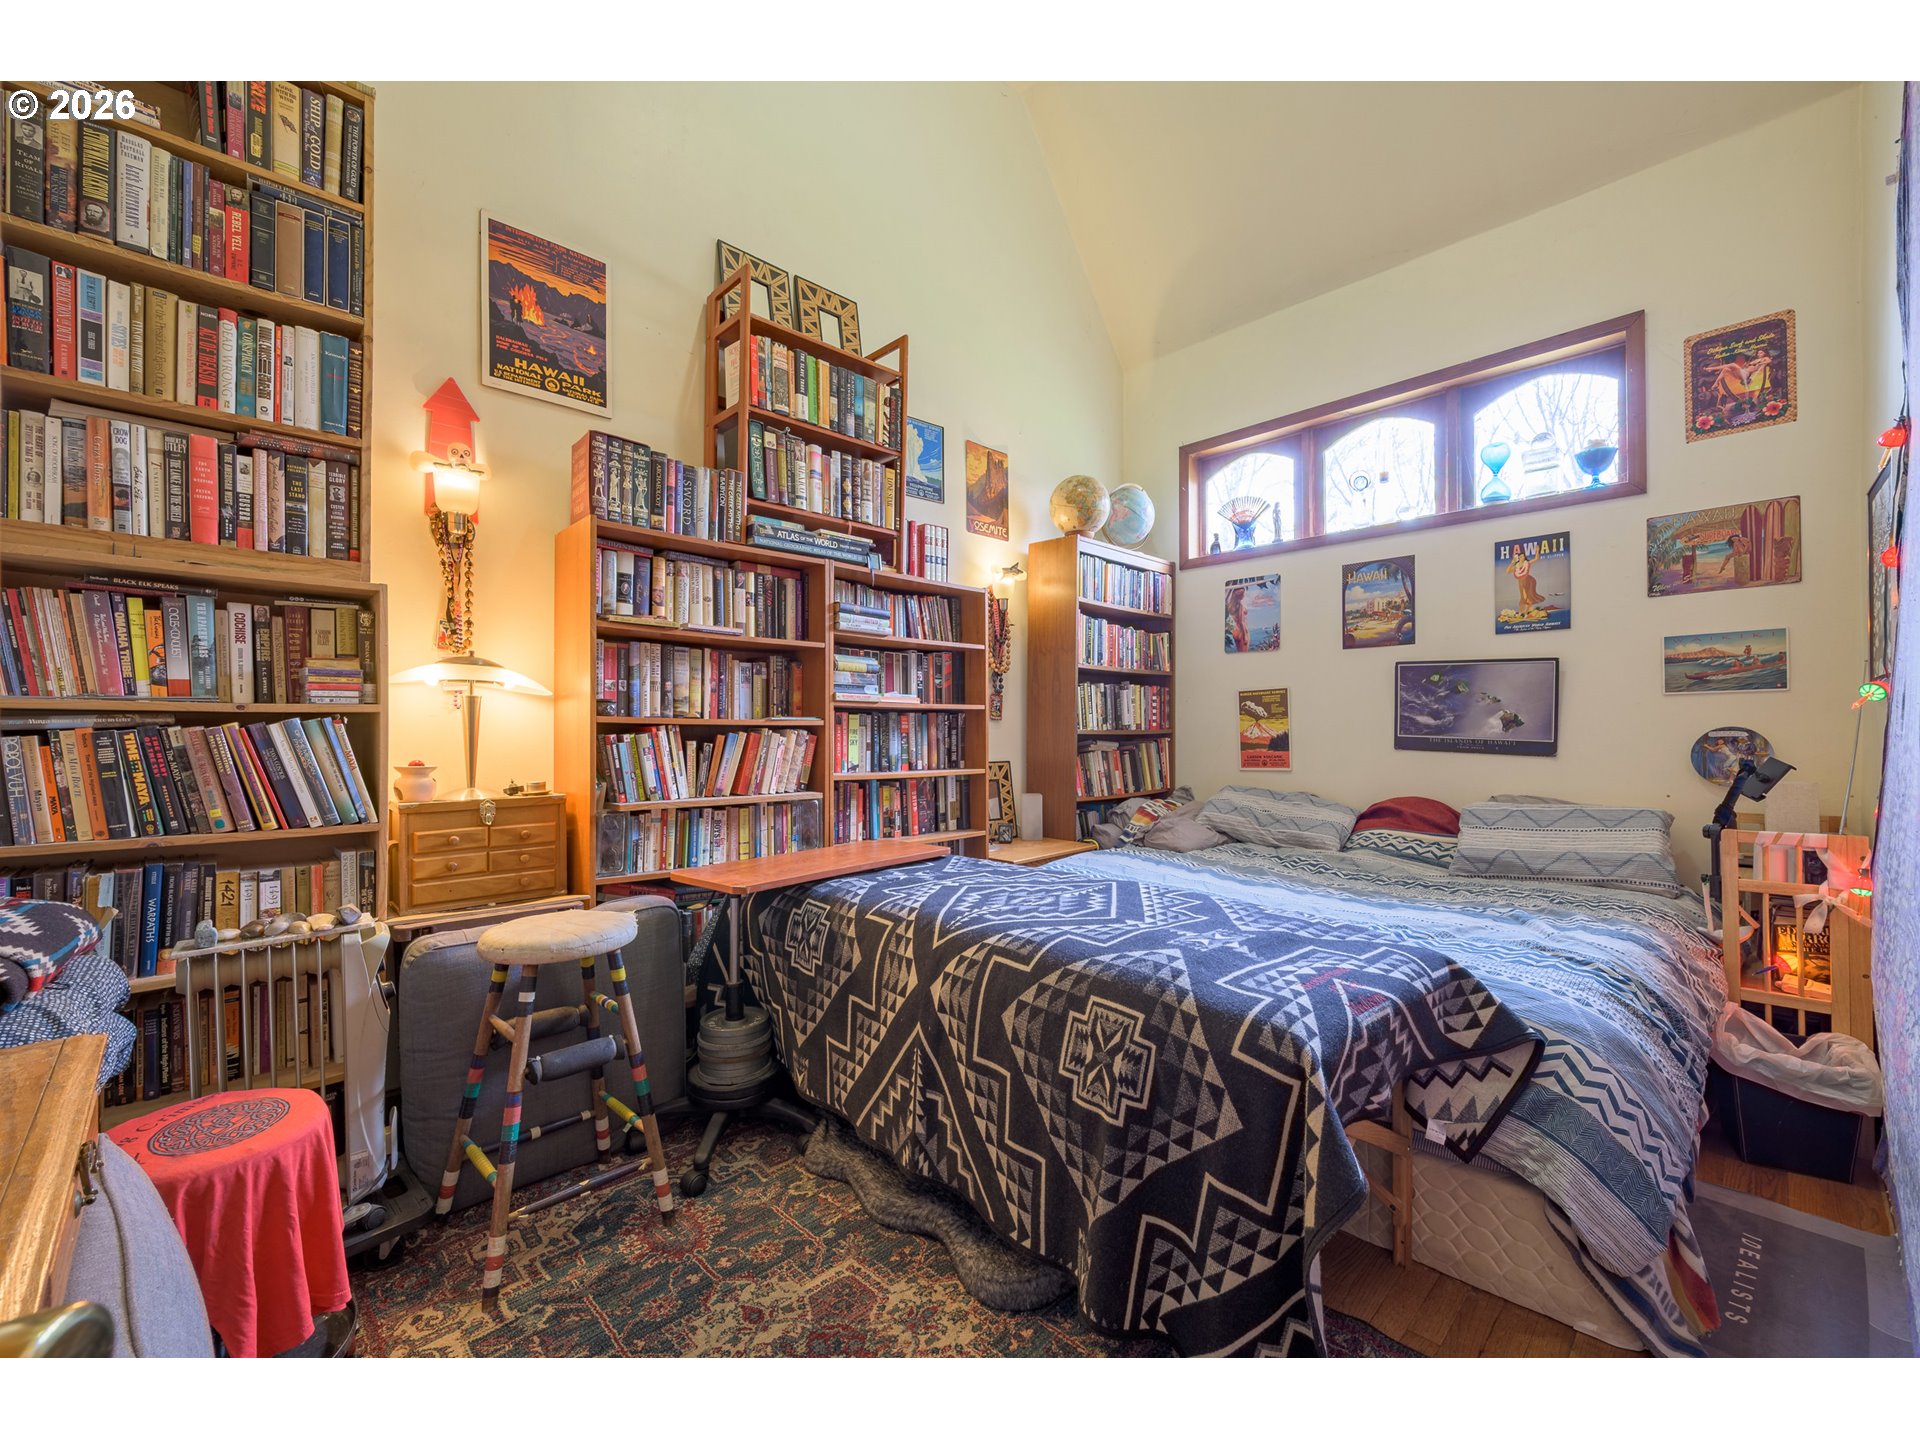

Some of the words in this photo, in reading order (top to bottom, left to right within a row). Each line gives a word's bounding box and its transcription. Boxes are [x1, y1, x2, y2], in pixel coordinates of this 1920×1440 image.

[278, 84, 293, 94] GONE
[310, 96, 320, 128] SHIP
[308, 125, 317, 134] of
[16, 150, 41, 162] TEAM
[83, 128, 109, 170] STONEWALL
[310, 135, 320, 170] GOLD
[14, 162, 43, 175] RIVALS
[351, 160, 357, 169] OF
[83, 167, 109, 202] JACKSON
[126, 183, 144, 228] LIEUTENANTS
[232, 211, 242, 232] REBEL
[231, 234, 241, 251] YELL
[56, 278, 72, 316] DERELICTION
[155, 298, 166, 307] For
[155, 310, 166, 320] the
[56, 324, 72, 342] DUTY
[199, 327, 217, 340] ACT
[222, 322, 232, 352] DEAD
[199, 340, 217, 352] OF
[241, 332, 253, 375] CONSPIRACY
[199, 352, 217, 386] TREASON
[222, 355, 232, 397] WRONG
[514, 358, 585, 386] HAWAII
[496, 363, 543, 381] NATIONAL
[562, 381, 601, 397] PARK
[113, 427, 128, 436] CROW
[115, 436, 128, 444] DOG
[165, 441, 187, 454] UTLEY
[170, 459, 181, 469] THE
[224, 453, 232, 463] THE
[94, 463, 103, 486] Horse
[170, 469, 181, 484] LANCE
[224, 464, 232, 490] AMERICAN
[170, 484, 181, 494] AND
[224, 491, 232, 505] WEST
[170, 495, 182, 505] THE
[239, 494, 250, 521] CUSTER
[683, 480, 692, 525] SWORD
[170, 505, 182, 522] SHIELD
[1673, 507, 1735, 526] HAWAII
[777, 531, 799, 541] ATLAS
[814, 538, 838, 548] WORLD
[1500, 538, 1564, 559] HAWAII
[1347, 567, 1387, 584] HAWAII
[154, 582, 179, 590] SPEAKS
[169, 608, 180, 627] CYCLES
[197, 603, 206, 614] THE
[115, 612, 129, 648] OMAHA
[198, 616, 207, 638] APACHE
[234, 612, 246, 644] COCHISE
[170, 630, 182, 658] CONQUEST
[199, 641, 209, 658] WARS
[260, 628, 270, 661] EMPIRE
[119, 650, 133, 678] TRIBE
[144, 737, 152, 746] OF
[5, 737, 21, 773] POPOL
[146, 749, 155, 763] THE
[152, 736, 160, 750] THE
[157, 753, 167, 777] HEART
[166, 750, 174, 761] The
[344, 750, 357, 771] MAYA
[123, 733, 140, 761] TIME
[133, 773, 150, 805] MAYA
[152, 763, 160, 778] SKY
[169, 762, 181, 782] MAYA
[8, 773, 24, 797] VUH
[33, 790, 42, 811] Mayan
[50, 796, 58, 815] MAYA
[165, 802, 174, 818] CANBY
[220, 879, 235, 906] 1421
[244, 884, 253, 901] 1491
[268, 885, 279, 905] 1493
[145, 898, 156, 943] WARPATHS
[160, 1054, 168, 1067] High
[1724, 1232, 1762, 1324] IDEALISTS
